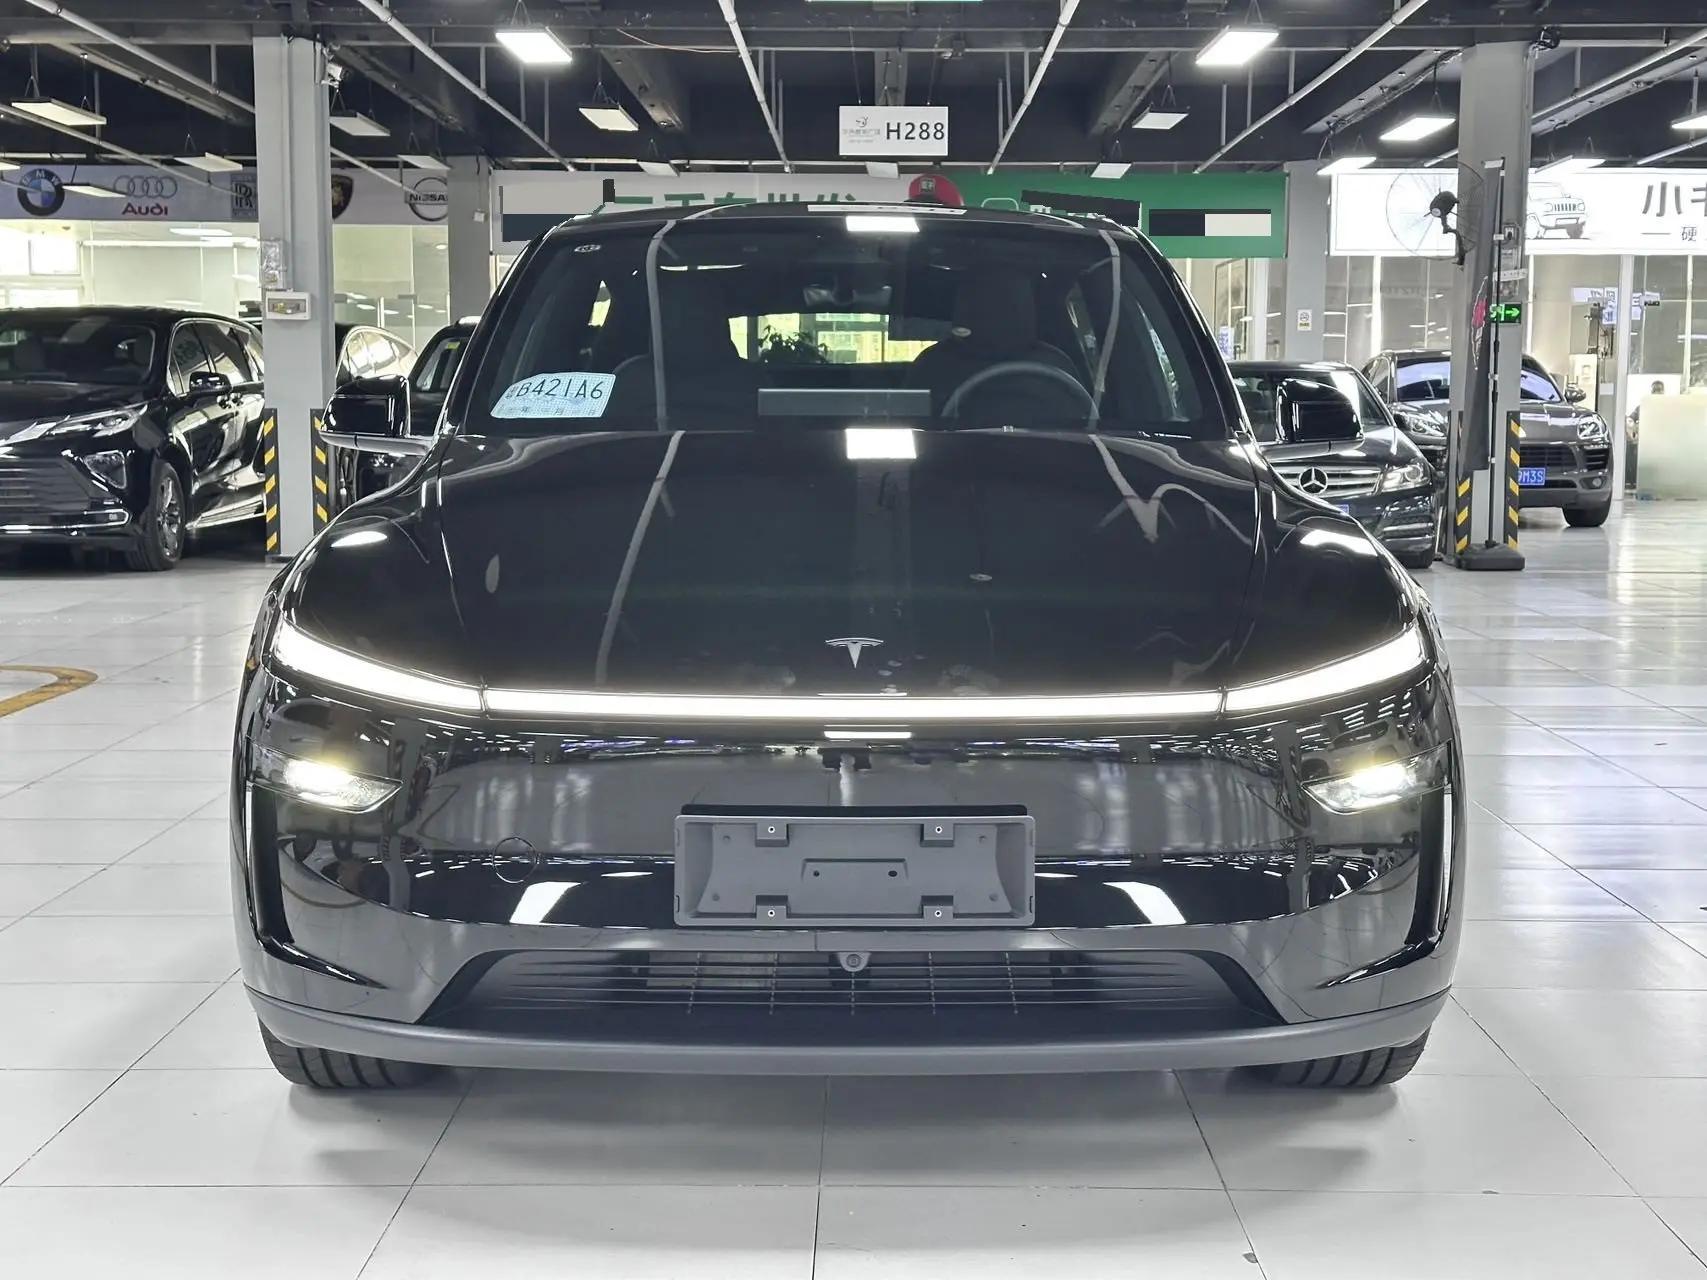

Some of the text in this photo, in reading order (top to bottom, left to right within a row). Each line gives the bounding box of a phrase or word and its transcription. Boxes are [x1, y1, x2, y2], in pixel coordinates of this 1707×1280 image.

[886, 121, 945, 140] H288
[409, 193, 448, 202] NISSA
[121, 203, 169, 216] Audi
